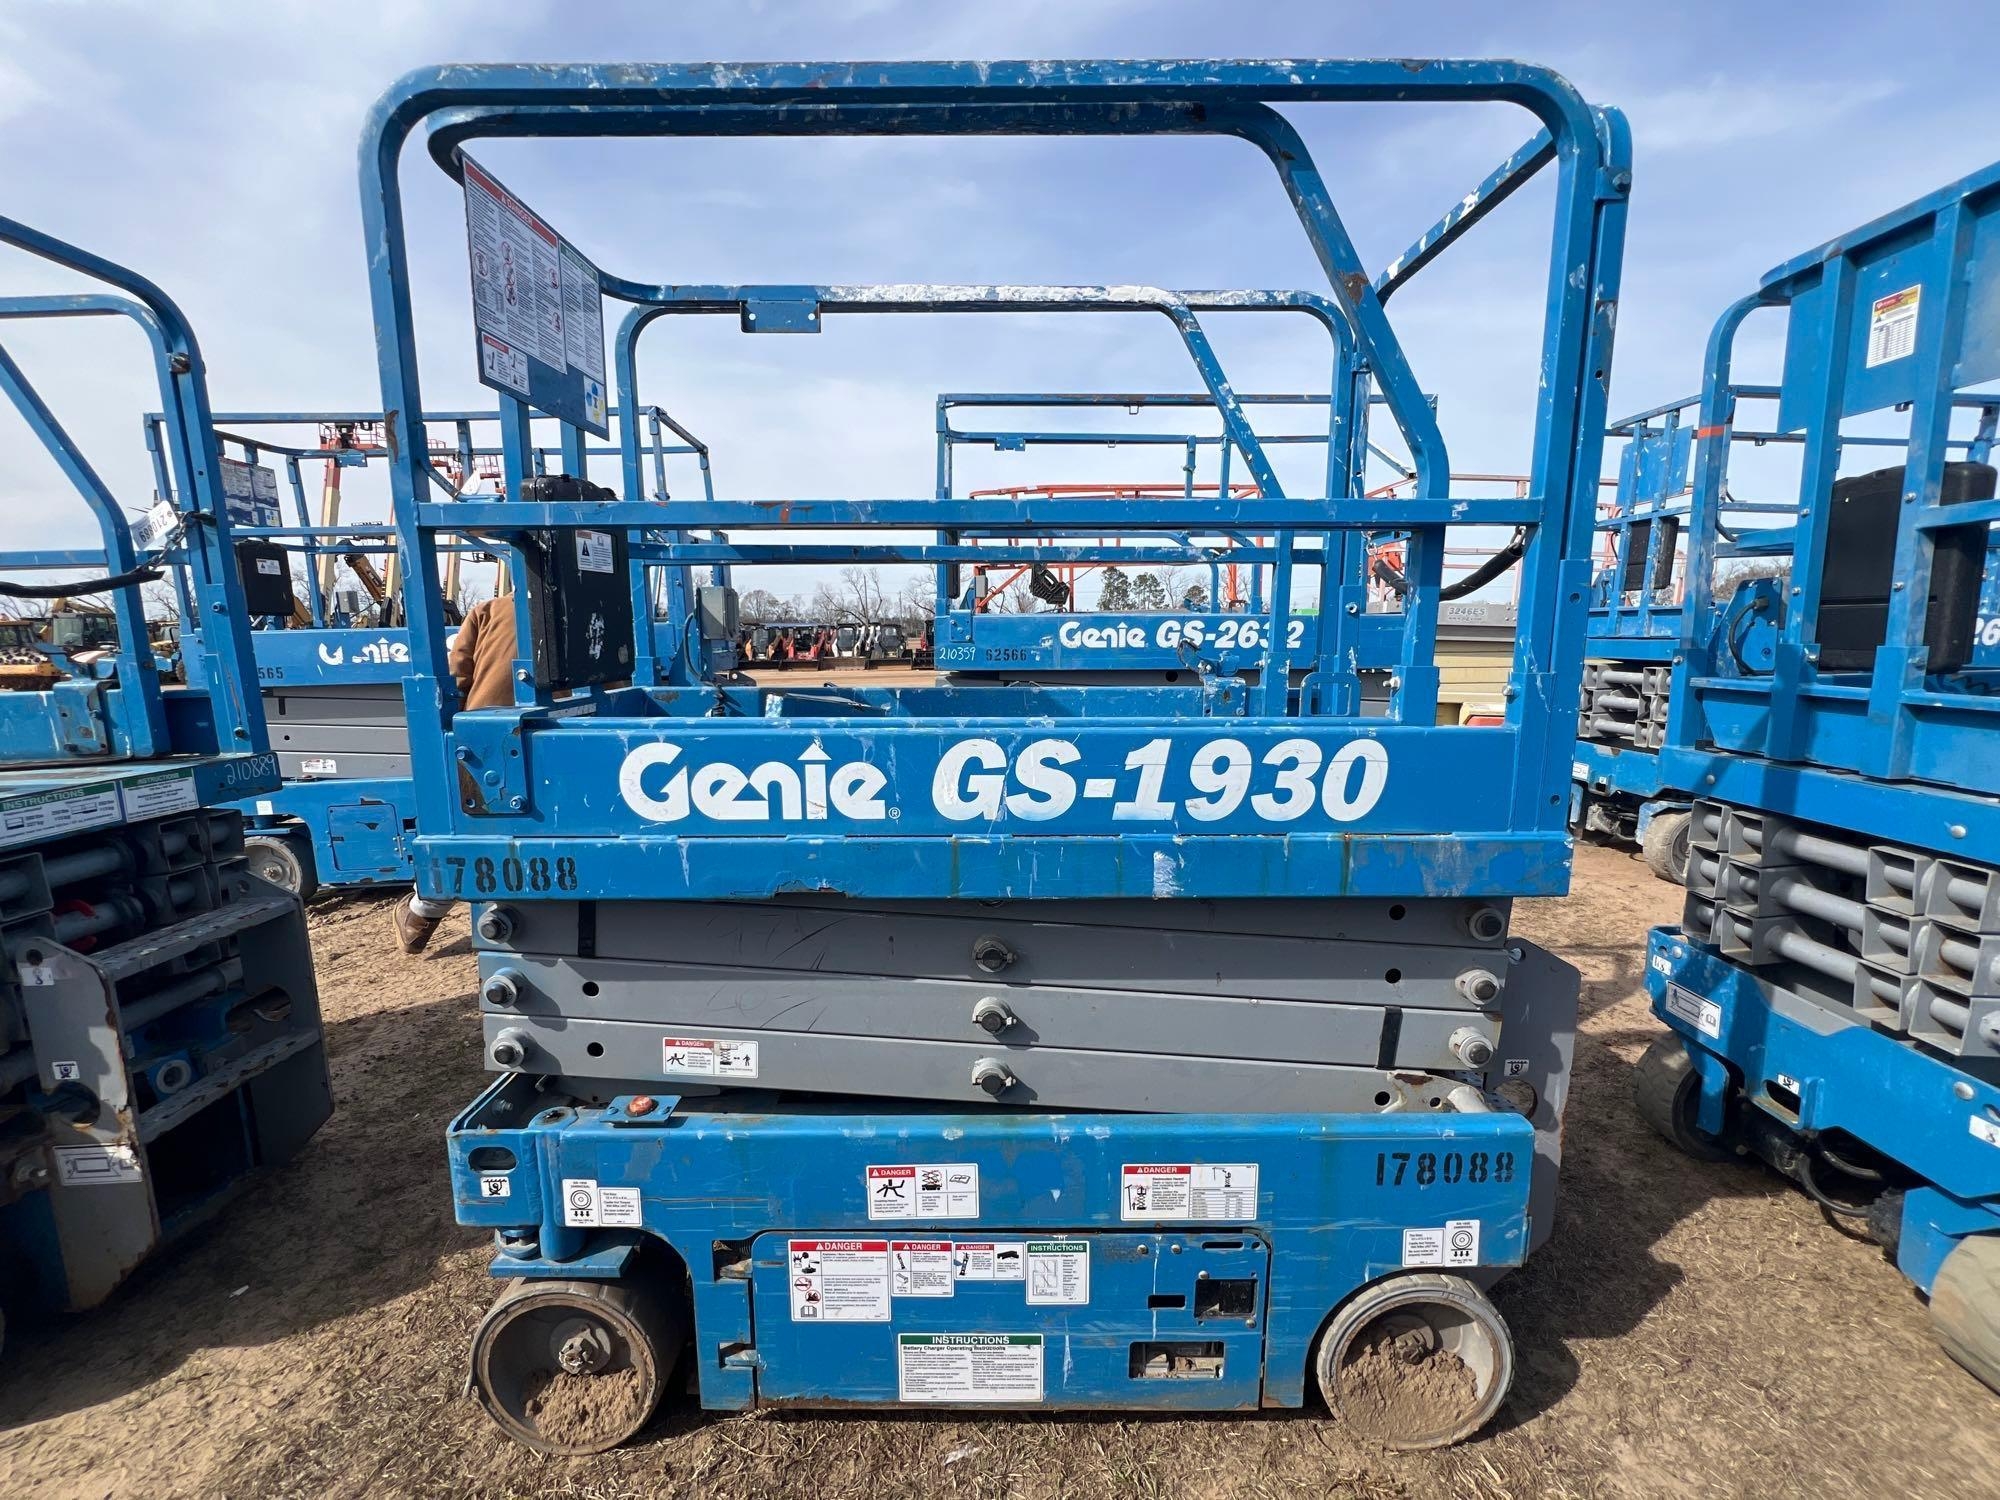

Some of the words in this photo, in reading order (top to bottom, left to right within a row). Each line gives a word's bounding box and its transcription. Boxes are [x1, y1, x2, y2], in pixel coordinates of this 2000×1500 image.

[1059, 621, 1146, 649] Genie
[939, 647, 976, 662] 210359
[224, 753, 278, 785] 210889
[619, 742, 886, 822] Genie
[931, 738, 1389, 822] GS-1930
[3, 788, 84, 811] INSTRUCTIONS
[431, 856, 578, 894] 178088
[1143, 1166, 1178, 1174] DANGER
[1376, 1151, 1515, 1187] 178088
[824, 1242, 863, 1251] DANGER
[911, 1243, 941, 1251] DANGER
[1030, 1244, 1084, 1252] INSTRUCTIONS
[932, 1335, 1010, 1345] INSTRUCTIONS
